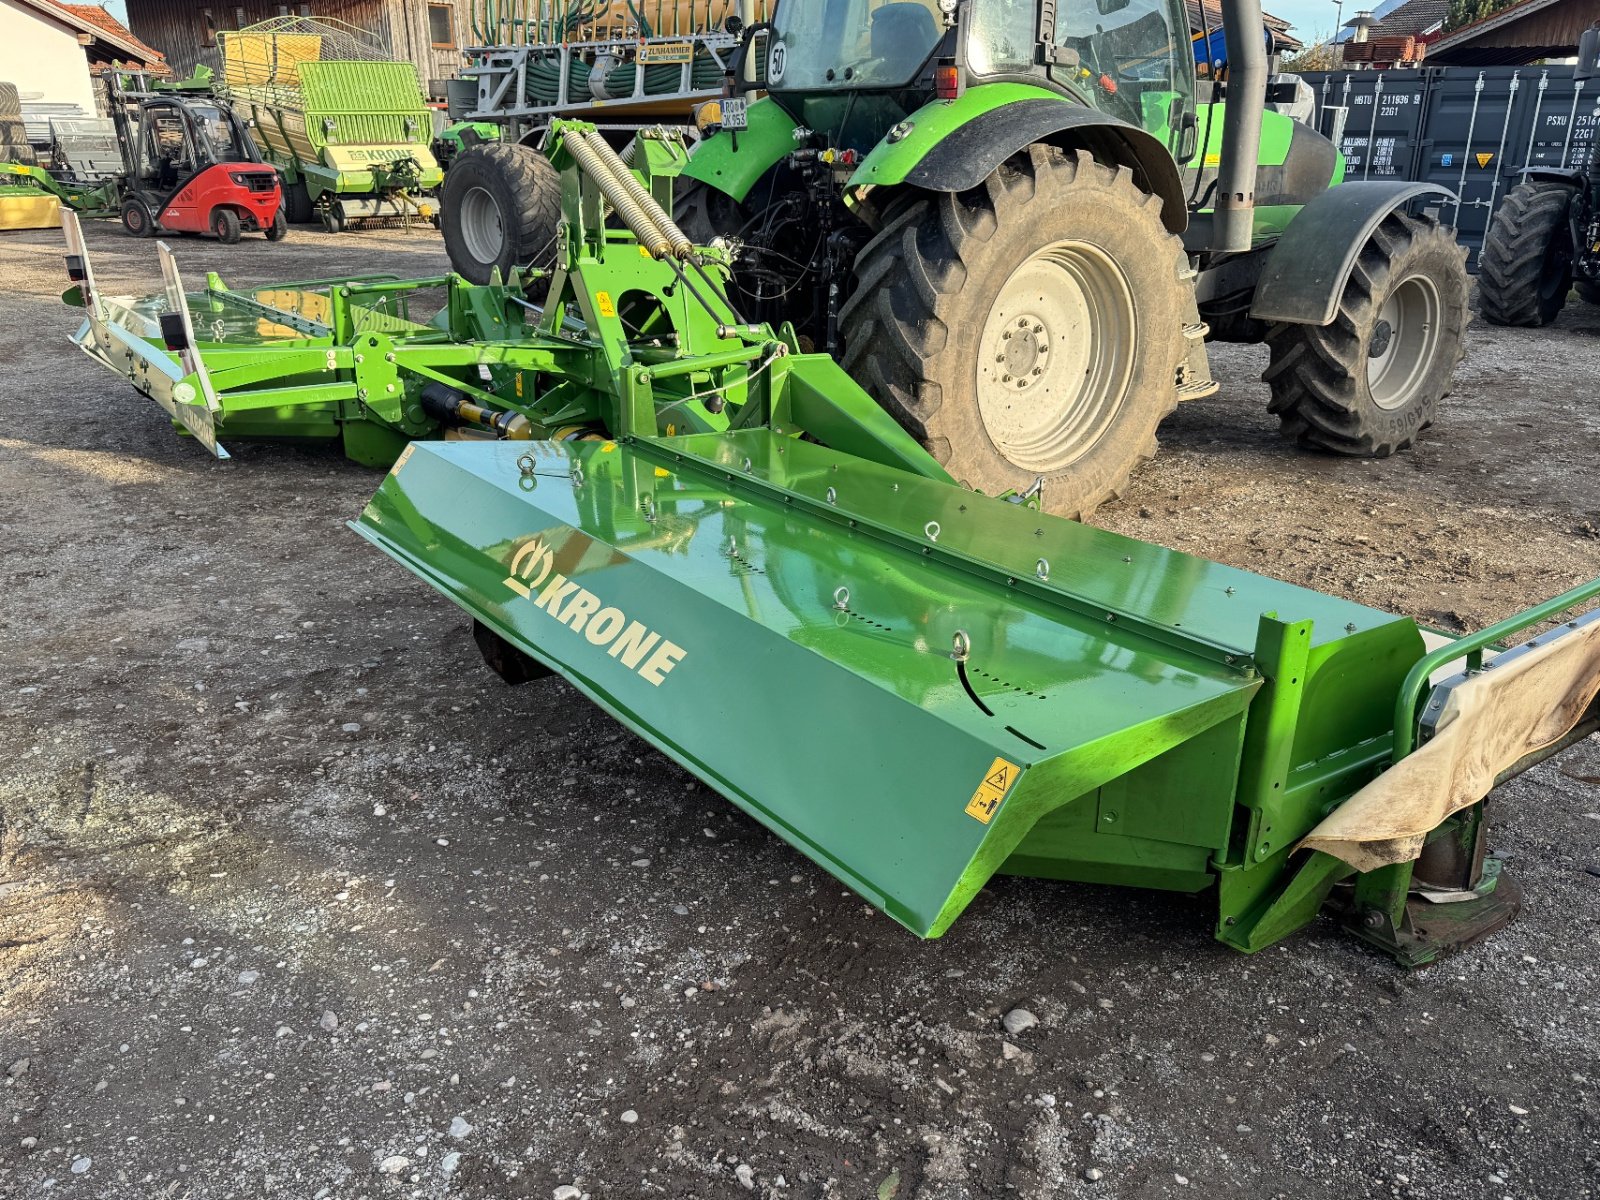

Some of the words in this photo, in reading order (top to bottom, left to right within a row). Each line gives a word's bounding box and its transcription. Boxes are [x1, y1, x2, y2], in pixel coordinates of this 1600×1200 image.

[772, 48, 784, 75] 50
[1382, 95, 1409, 104] 211936
[1380, 107, 1398, 116] 22G1
[732, 113, 745, 125] 953
[1546, 115, 1567, 126] PSXU
[1574, 129, 1594, 139] 22G1
[533, 573, 688, 687] KRONE
